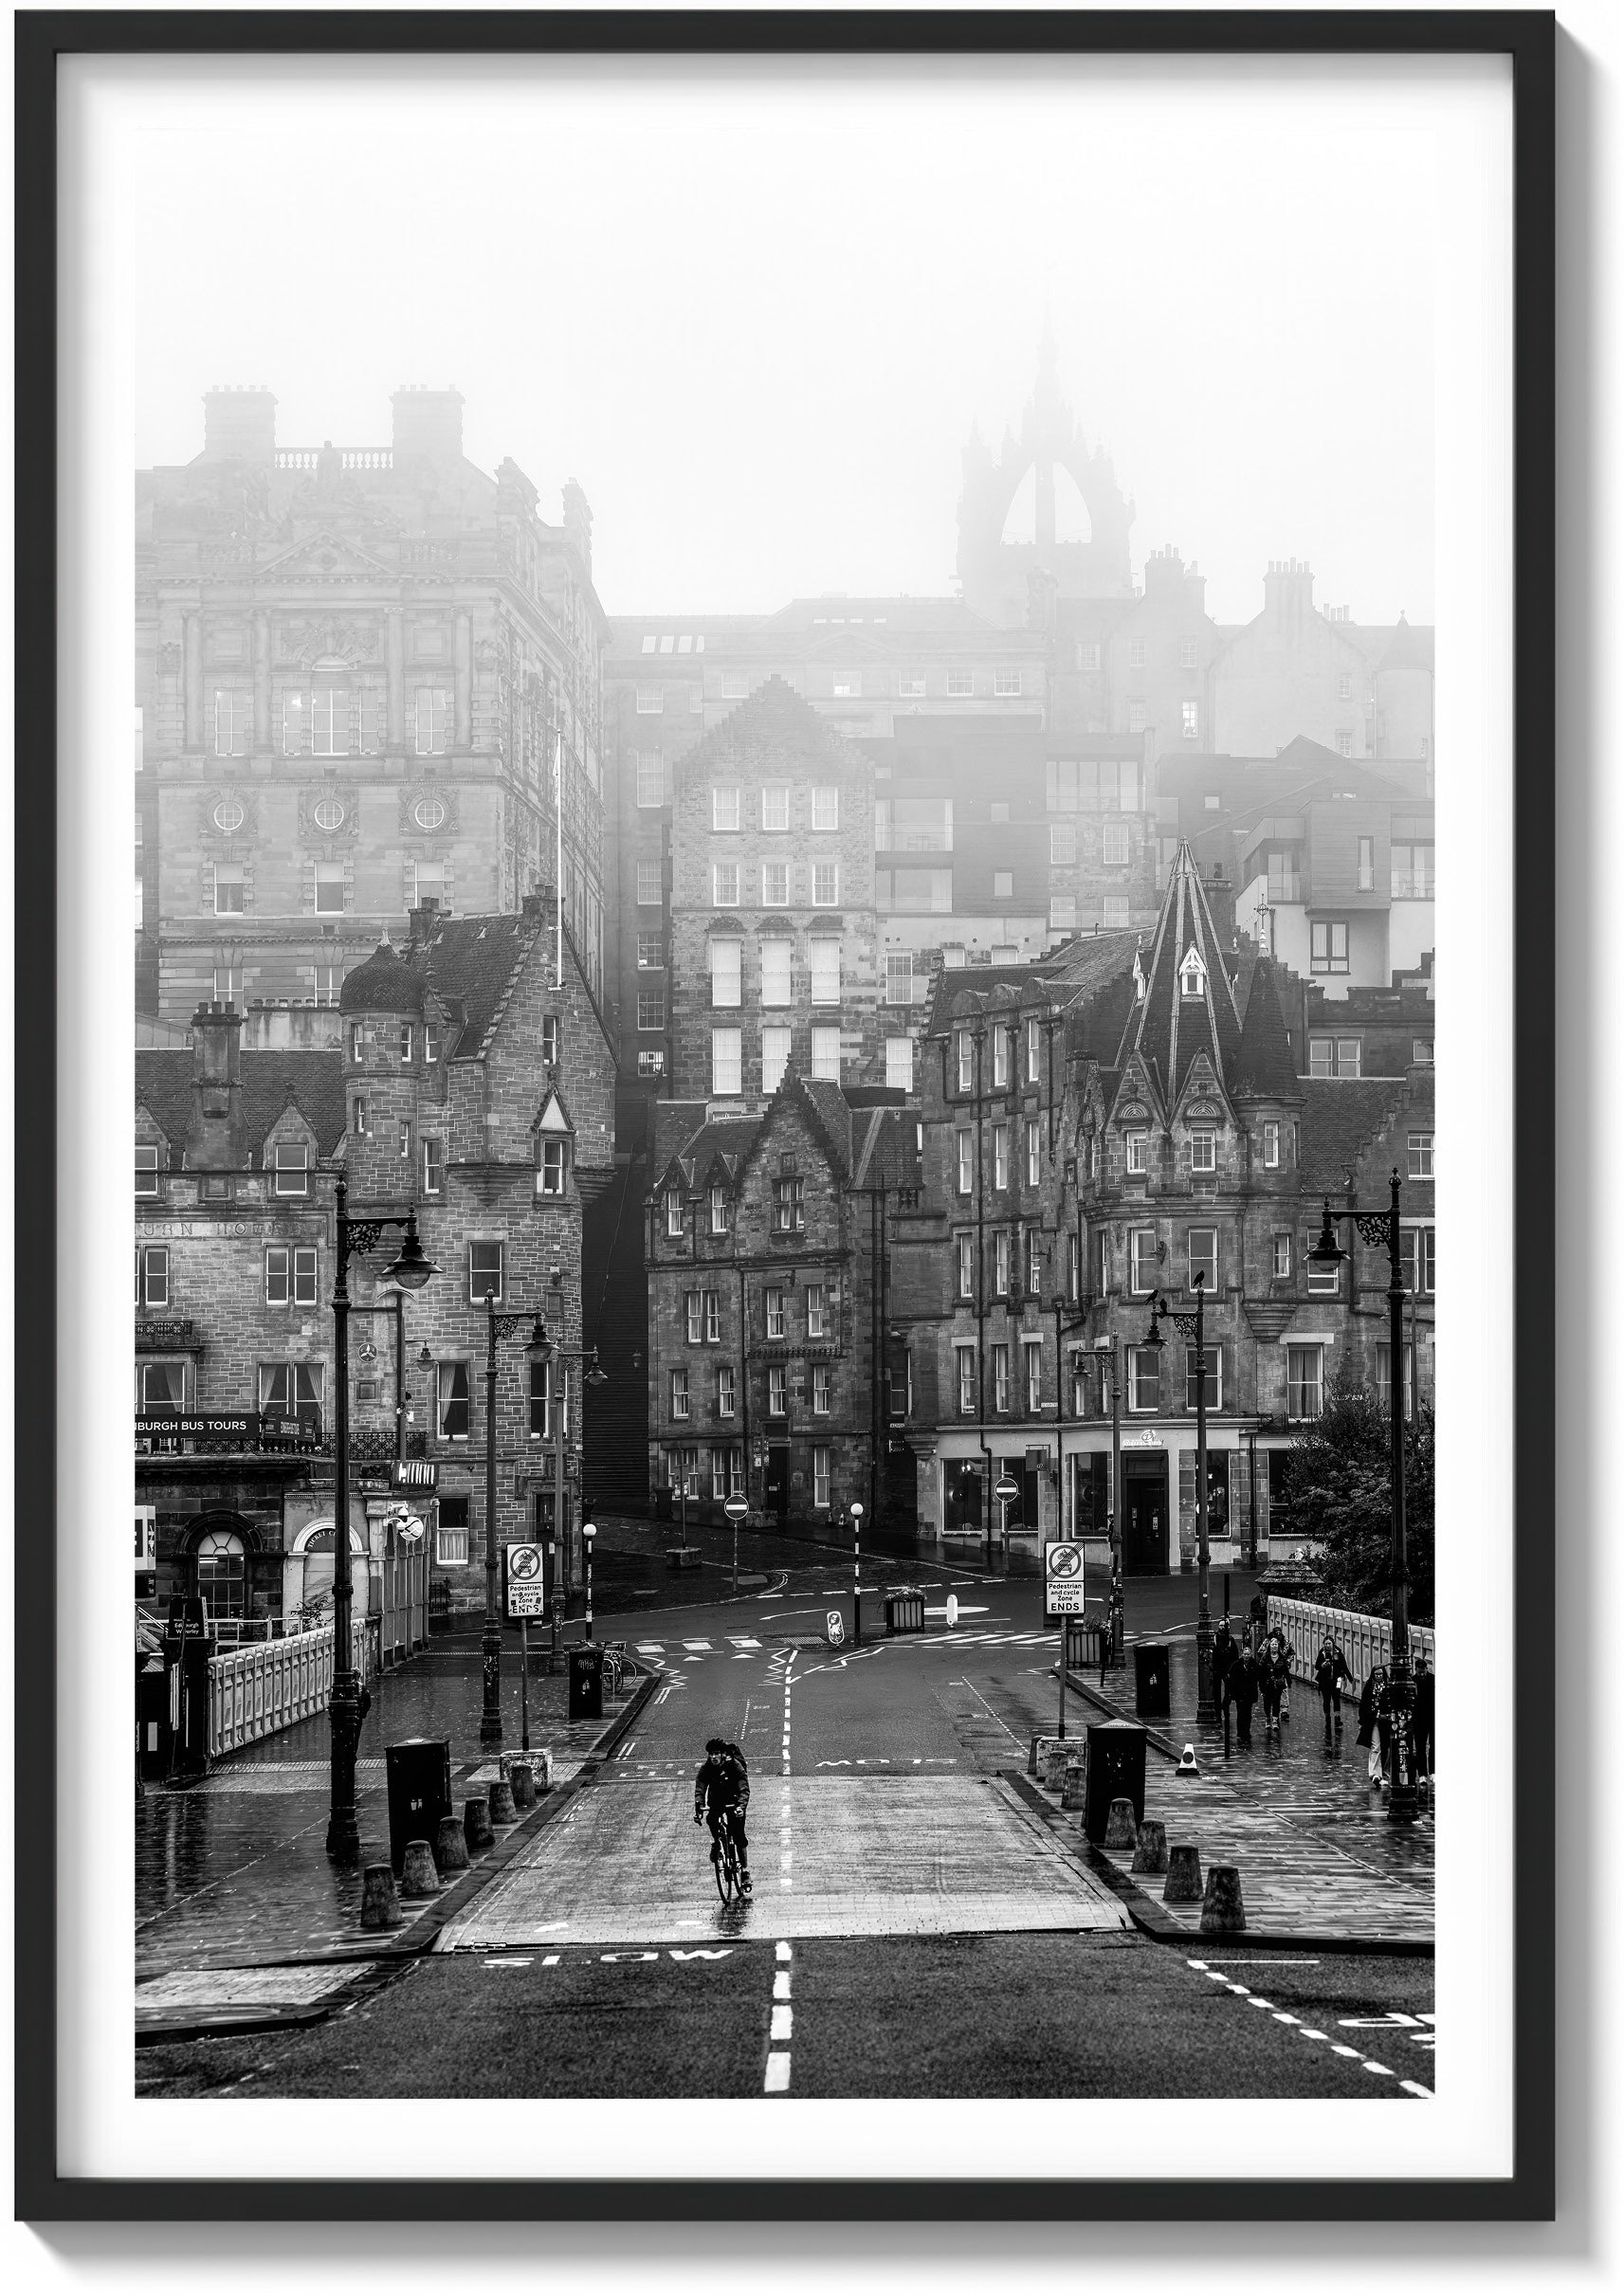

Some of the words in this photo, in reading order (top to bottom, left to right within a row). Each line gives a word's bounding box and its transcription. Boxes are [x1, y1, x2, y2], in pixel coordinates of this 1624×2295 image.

[135, 1223, 193, 1235] URN
[181, 1421, 205, 1431] BUS
[207, 1420, 247, 1430] TOURS
[307, 1530, 326, 1548] TICKET
[1050, 1602, 1080, 1612] ENDS
[480, 1949, 734, 1968] SLOW
